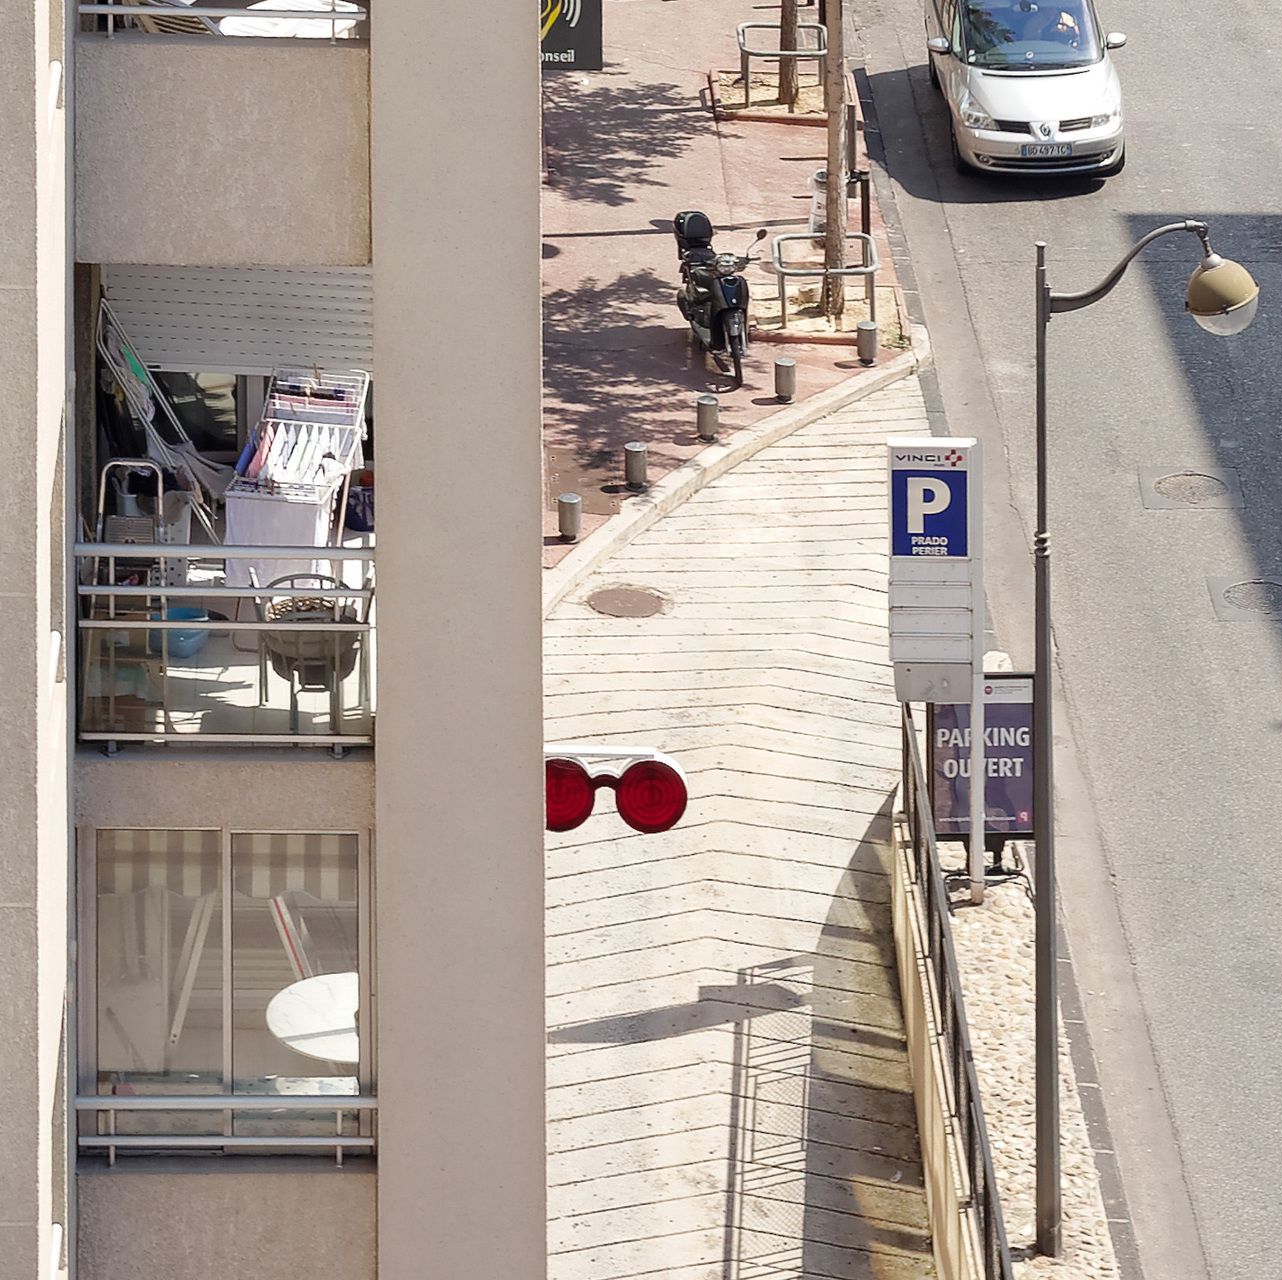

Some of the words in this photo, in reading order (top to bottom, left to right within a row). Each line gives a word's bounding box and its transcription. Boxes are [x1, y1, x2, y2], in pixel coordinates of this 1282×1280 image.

[907, 477, 951, 533] P
[911, 537, 948, 545] PRADO
[912, 547, 948, 555] PERIER
[944, 758, 1024, 778] OUERT
